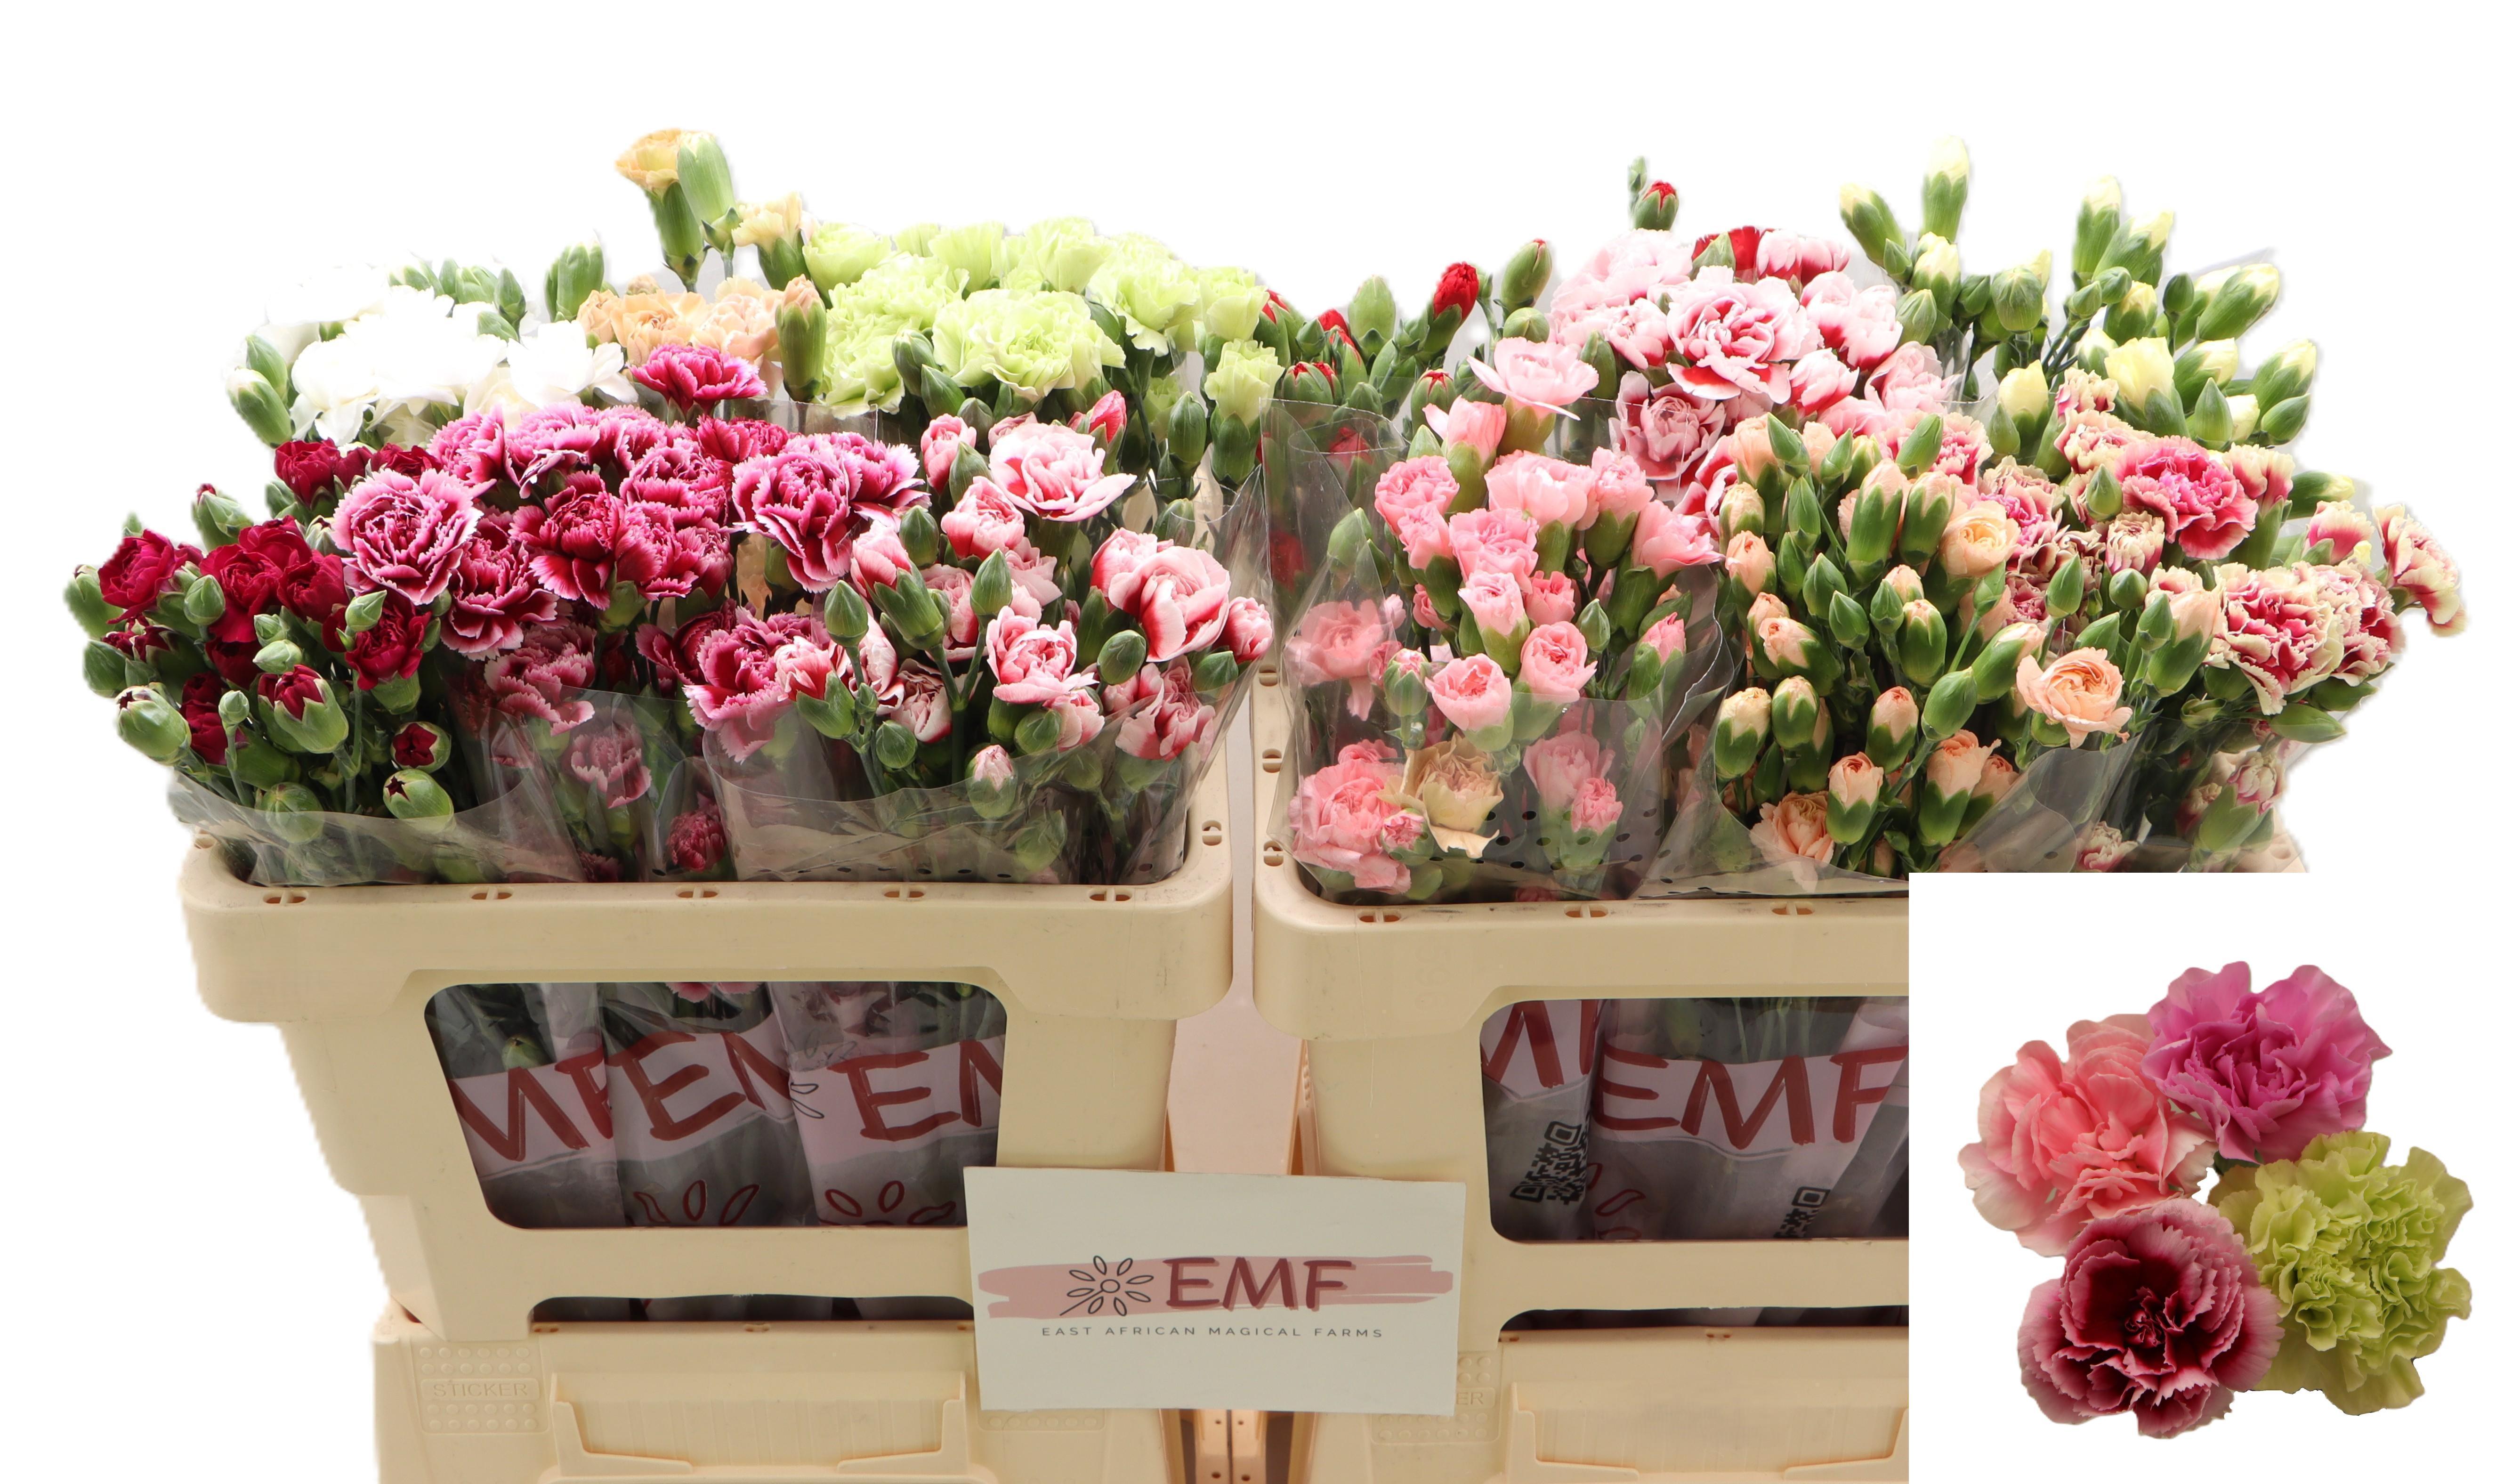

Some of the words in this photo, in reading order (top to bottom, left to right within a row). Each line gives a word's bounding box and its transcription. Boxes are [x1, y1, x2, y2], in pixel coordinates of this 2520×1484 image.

[1590, 1043, 1909, 1150] EMF
[1163, 1257, 1355, 1311] EMF
[1042, 1327, 1092, 1337] EAST
[1105, 1326, 1196, 1336] AFRICAN
[1209, 1327, 1301, 1337] MAGICAL
[1314, 1328, 1383, 1338] FARMS
[433, 1383, 528, 1397] STICKER
